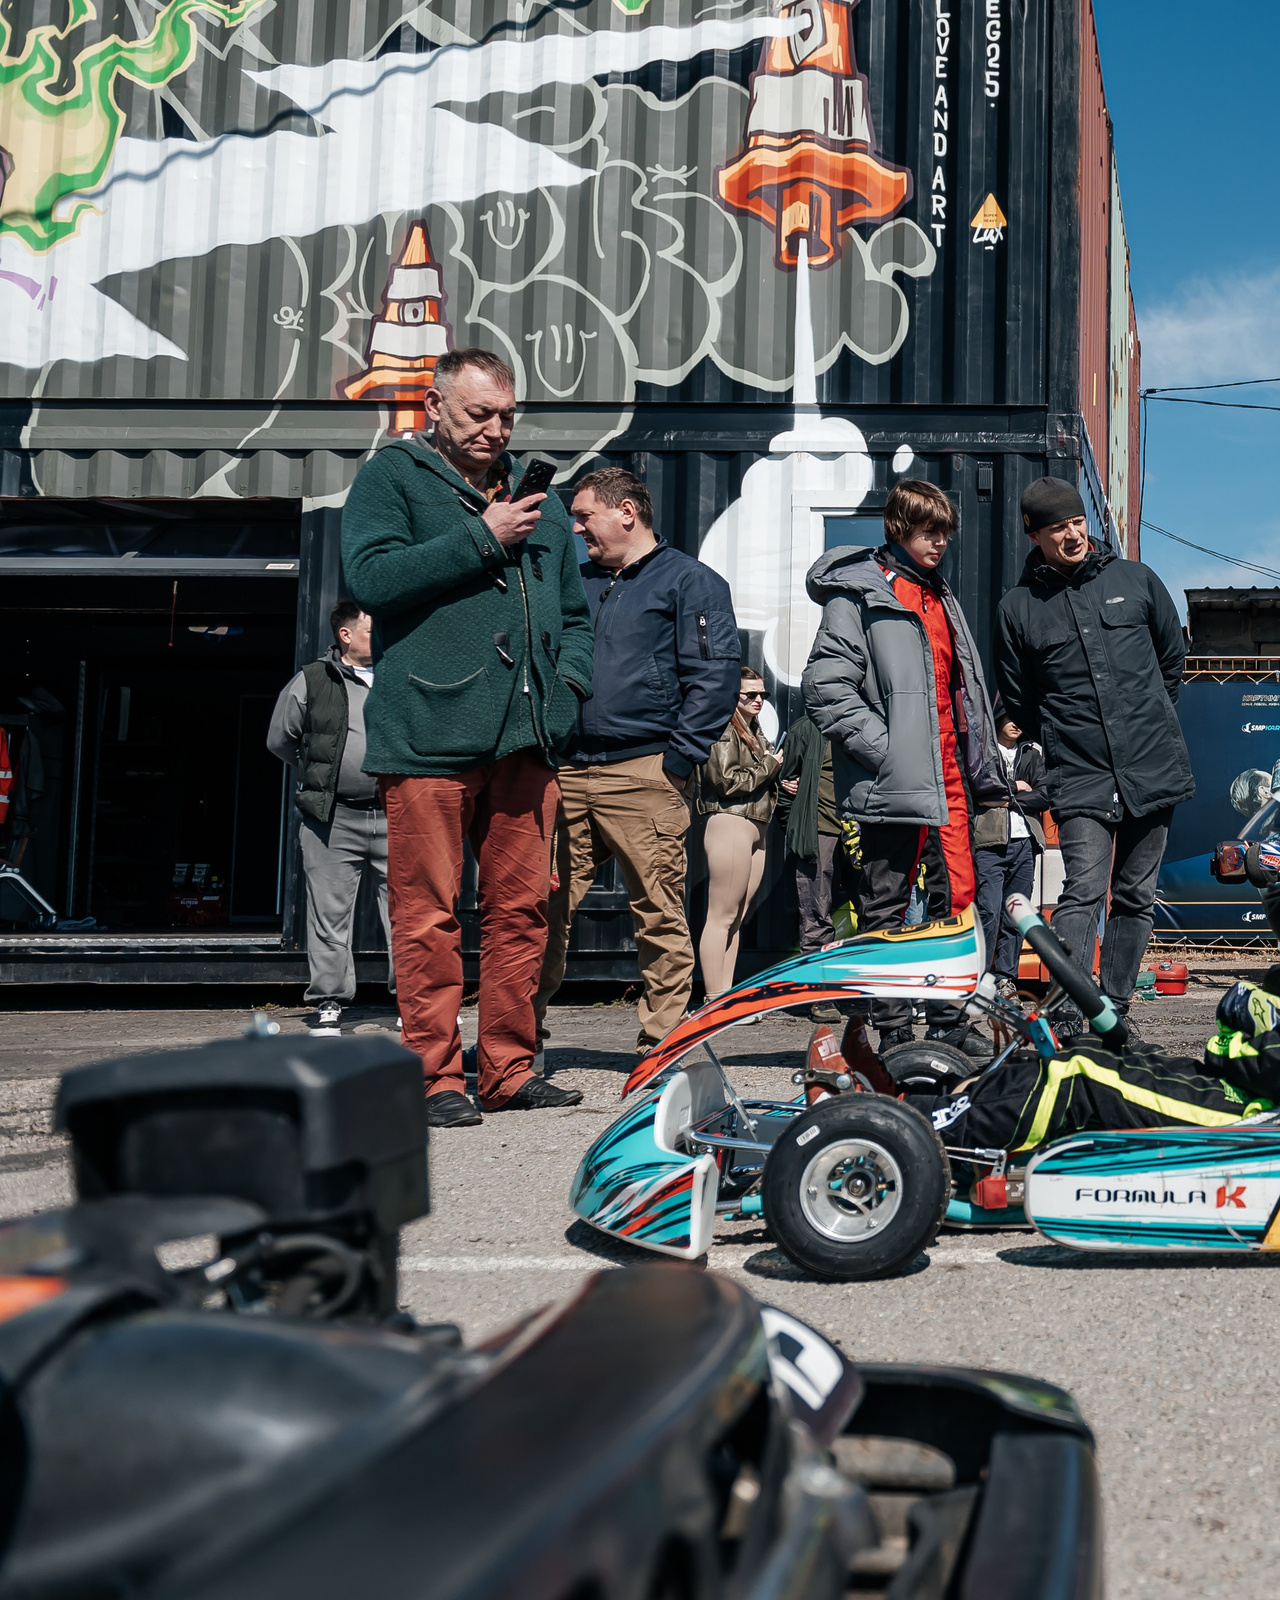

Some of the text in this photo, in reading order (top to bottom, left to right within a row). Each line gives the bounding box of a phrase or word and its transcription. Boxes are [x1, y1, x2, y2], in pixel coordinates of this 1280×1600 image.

[931, 0, 951, 248] LOVE AND ART
[1075, 1185, 1247, 1209] FORMULA K
